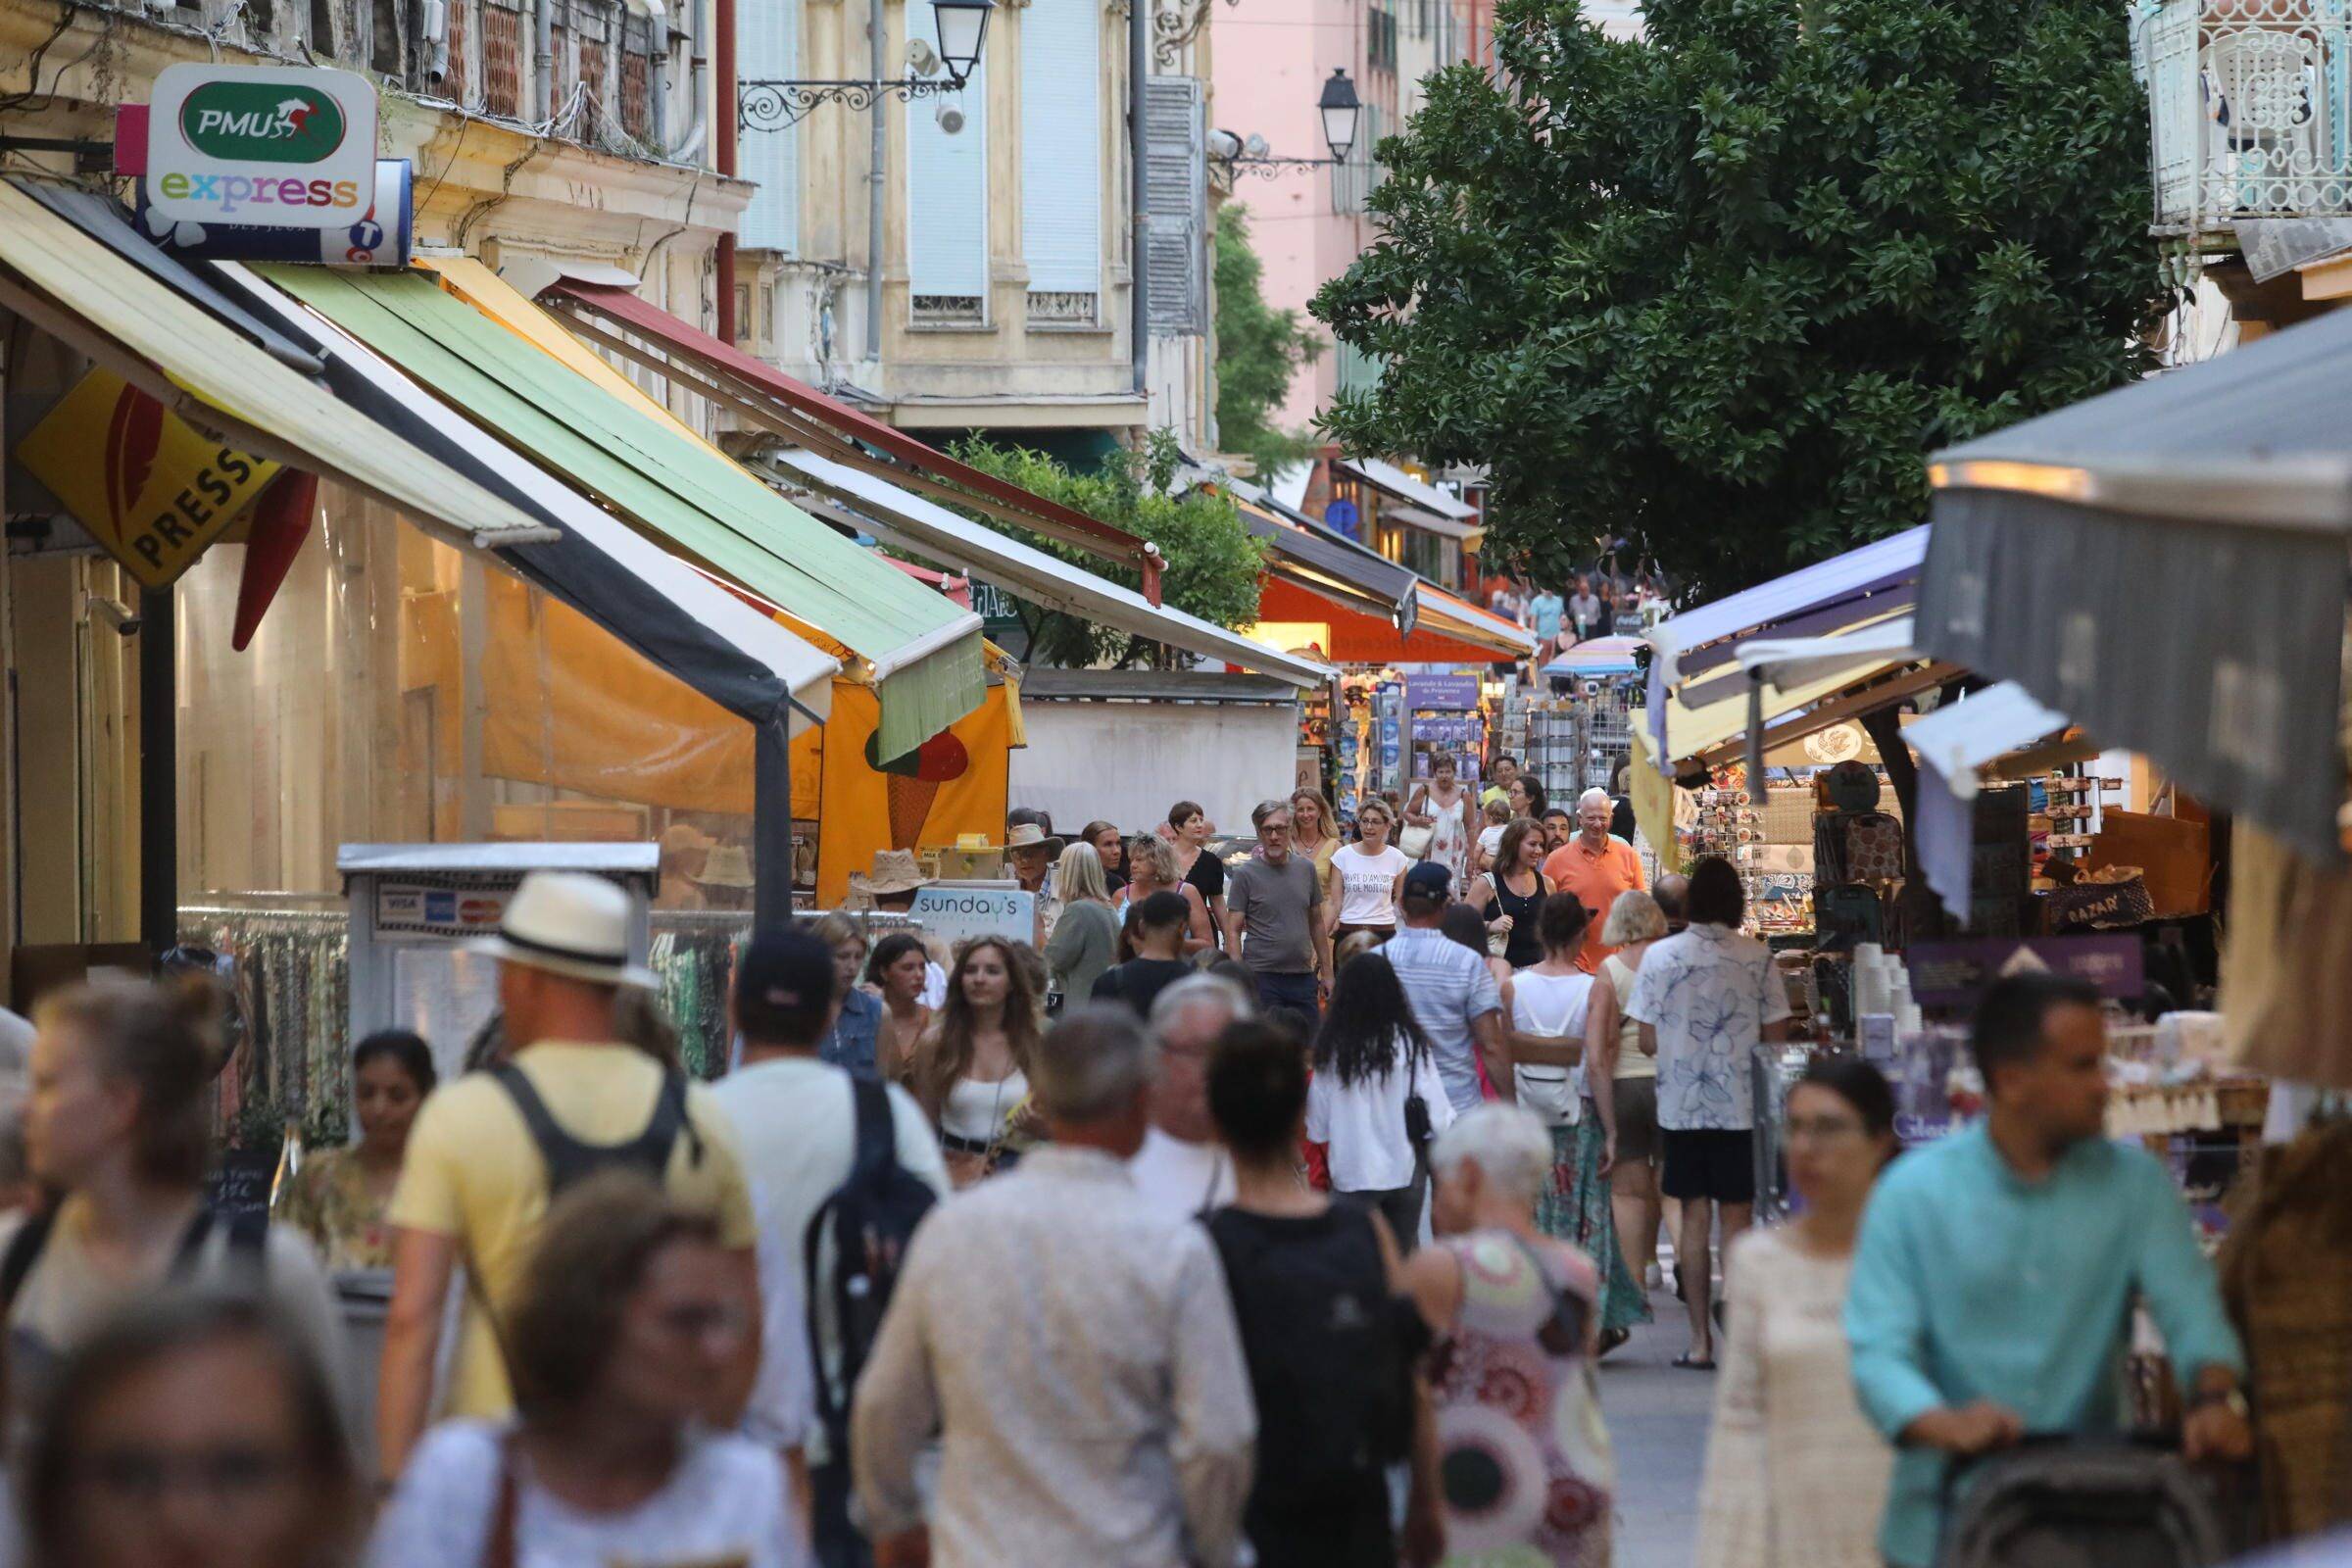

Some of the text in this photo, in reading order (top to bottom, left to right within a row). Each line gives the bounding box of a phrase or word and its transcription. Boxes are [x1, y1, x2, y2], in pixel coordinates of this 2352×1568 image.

[198, 109, 273, 137] PMU
[160, 172, 359, 213] express
[133, 447, 267, 570] PRESS
[919, 896, 1017, 923] sunday's
